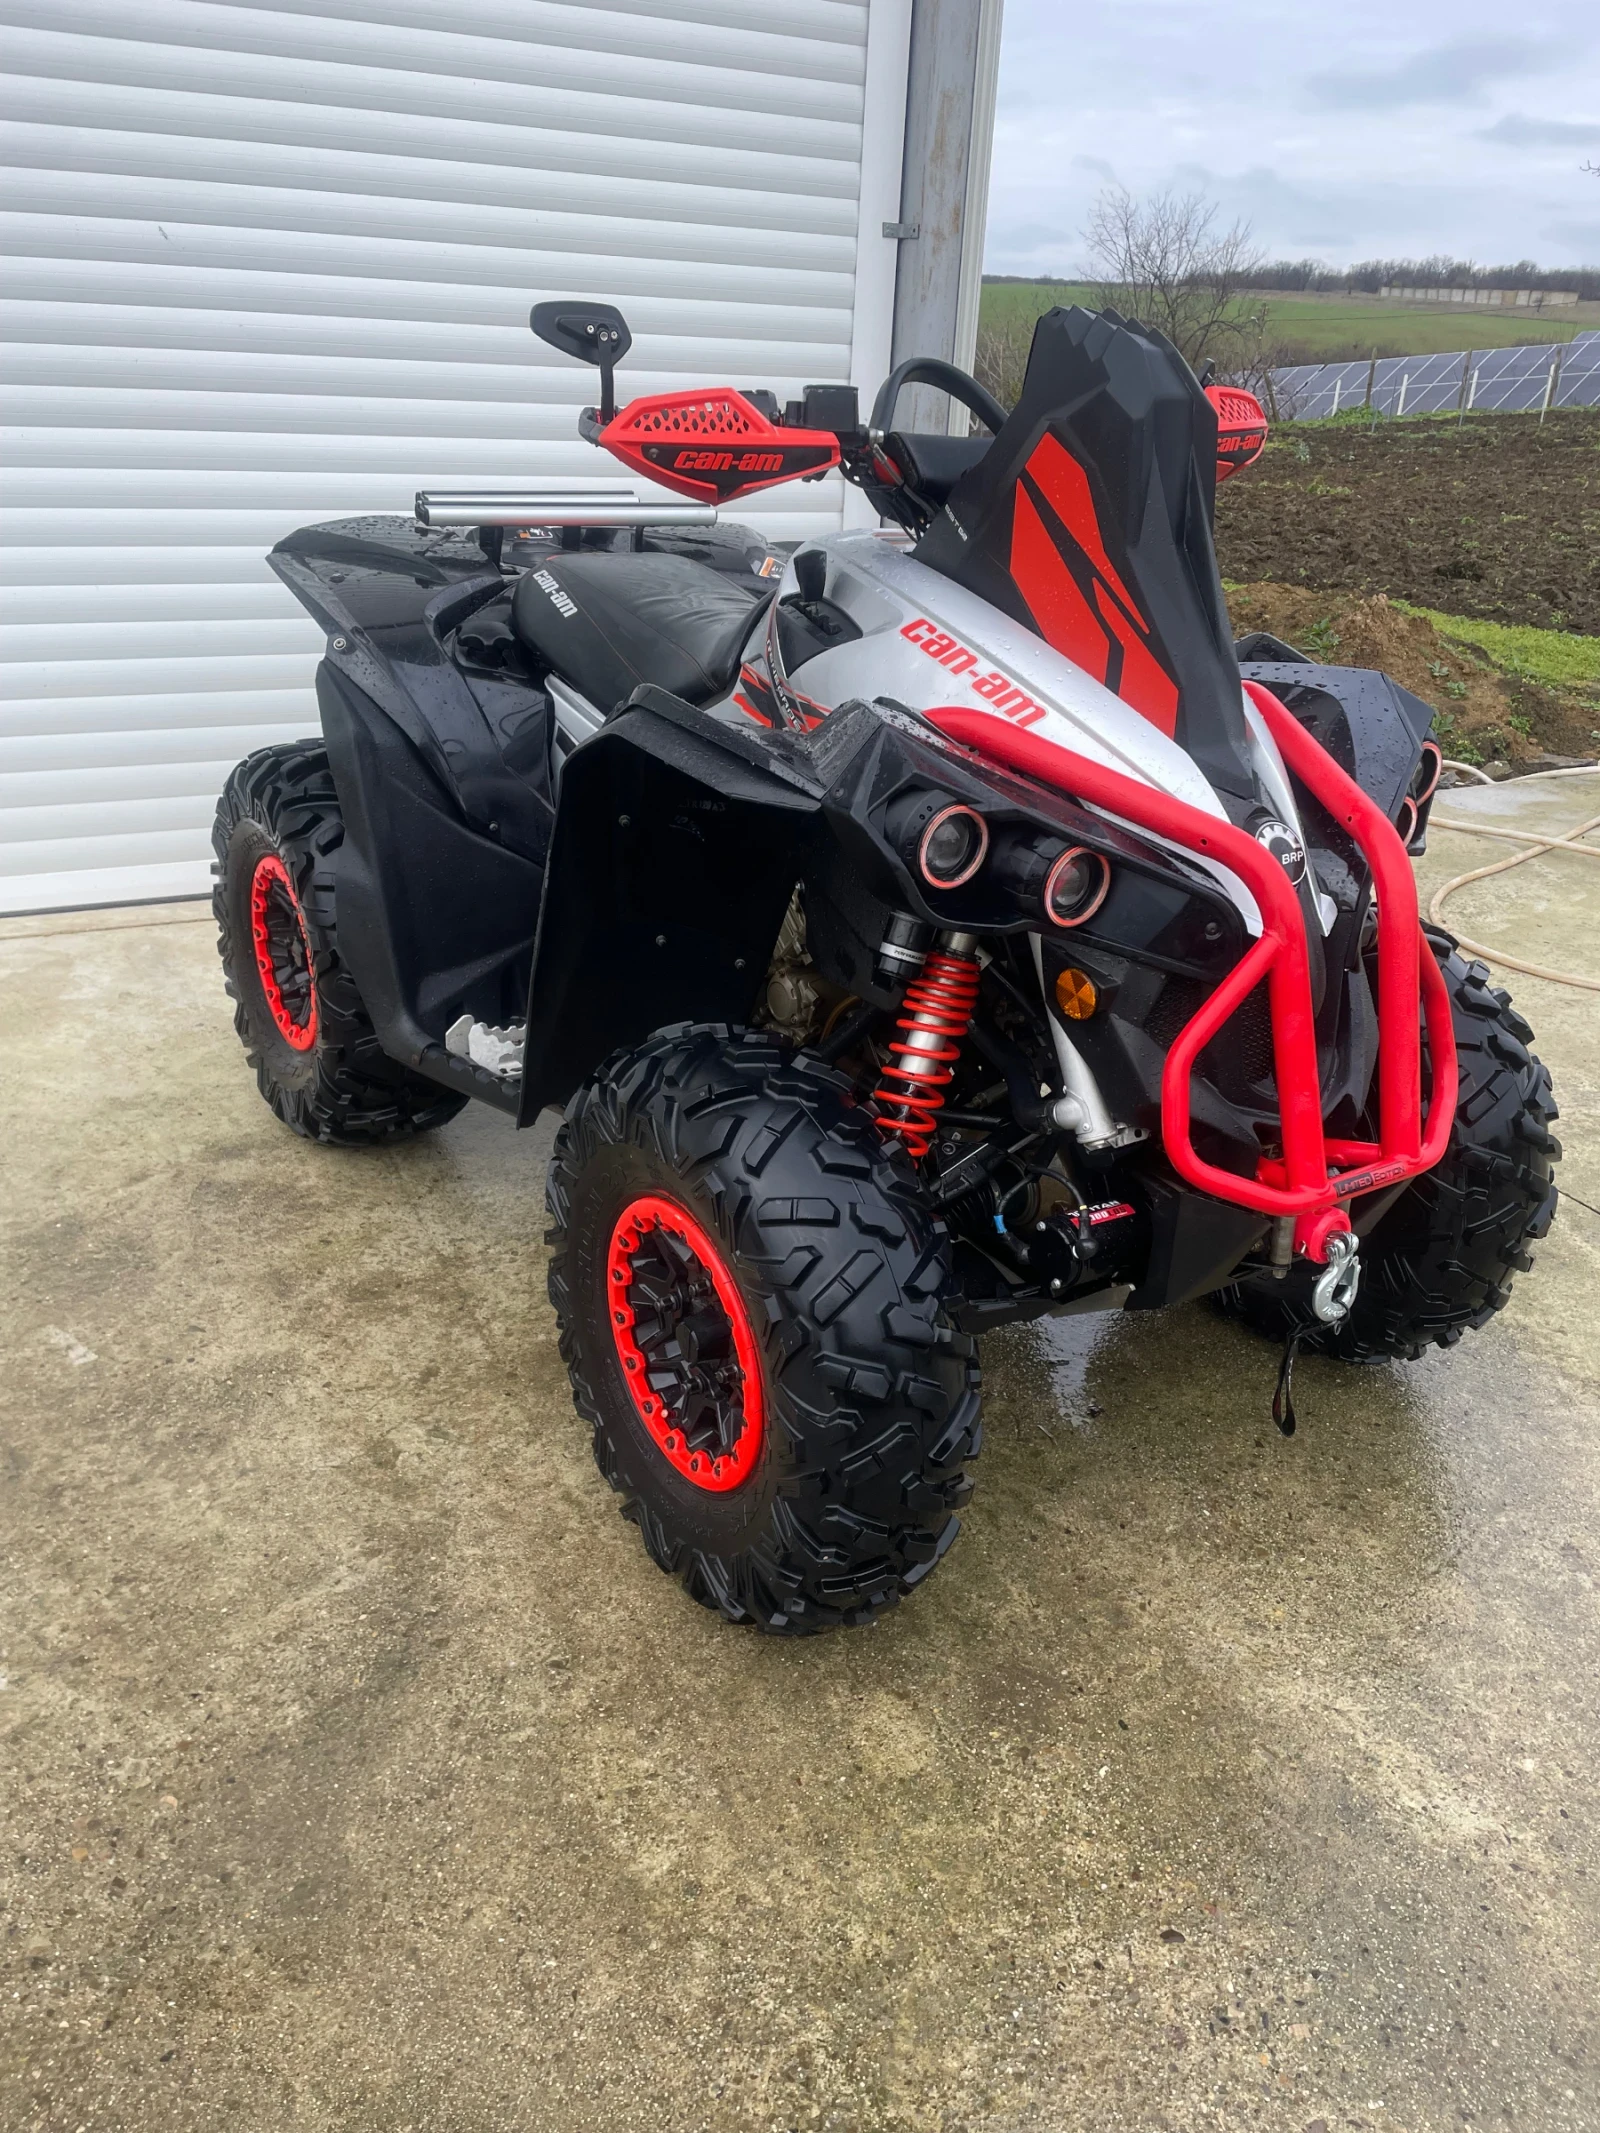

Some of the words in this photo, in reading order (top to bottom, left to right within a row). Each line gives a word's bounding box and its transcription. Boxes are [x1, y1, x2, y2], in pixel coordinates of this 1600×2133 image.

[673, 450, 784, 472] can-am
[532, 569, 578, 618] can-am
[899, 617, 1049, 728] can-am
[1281, 850, 1304, 865] BRP
